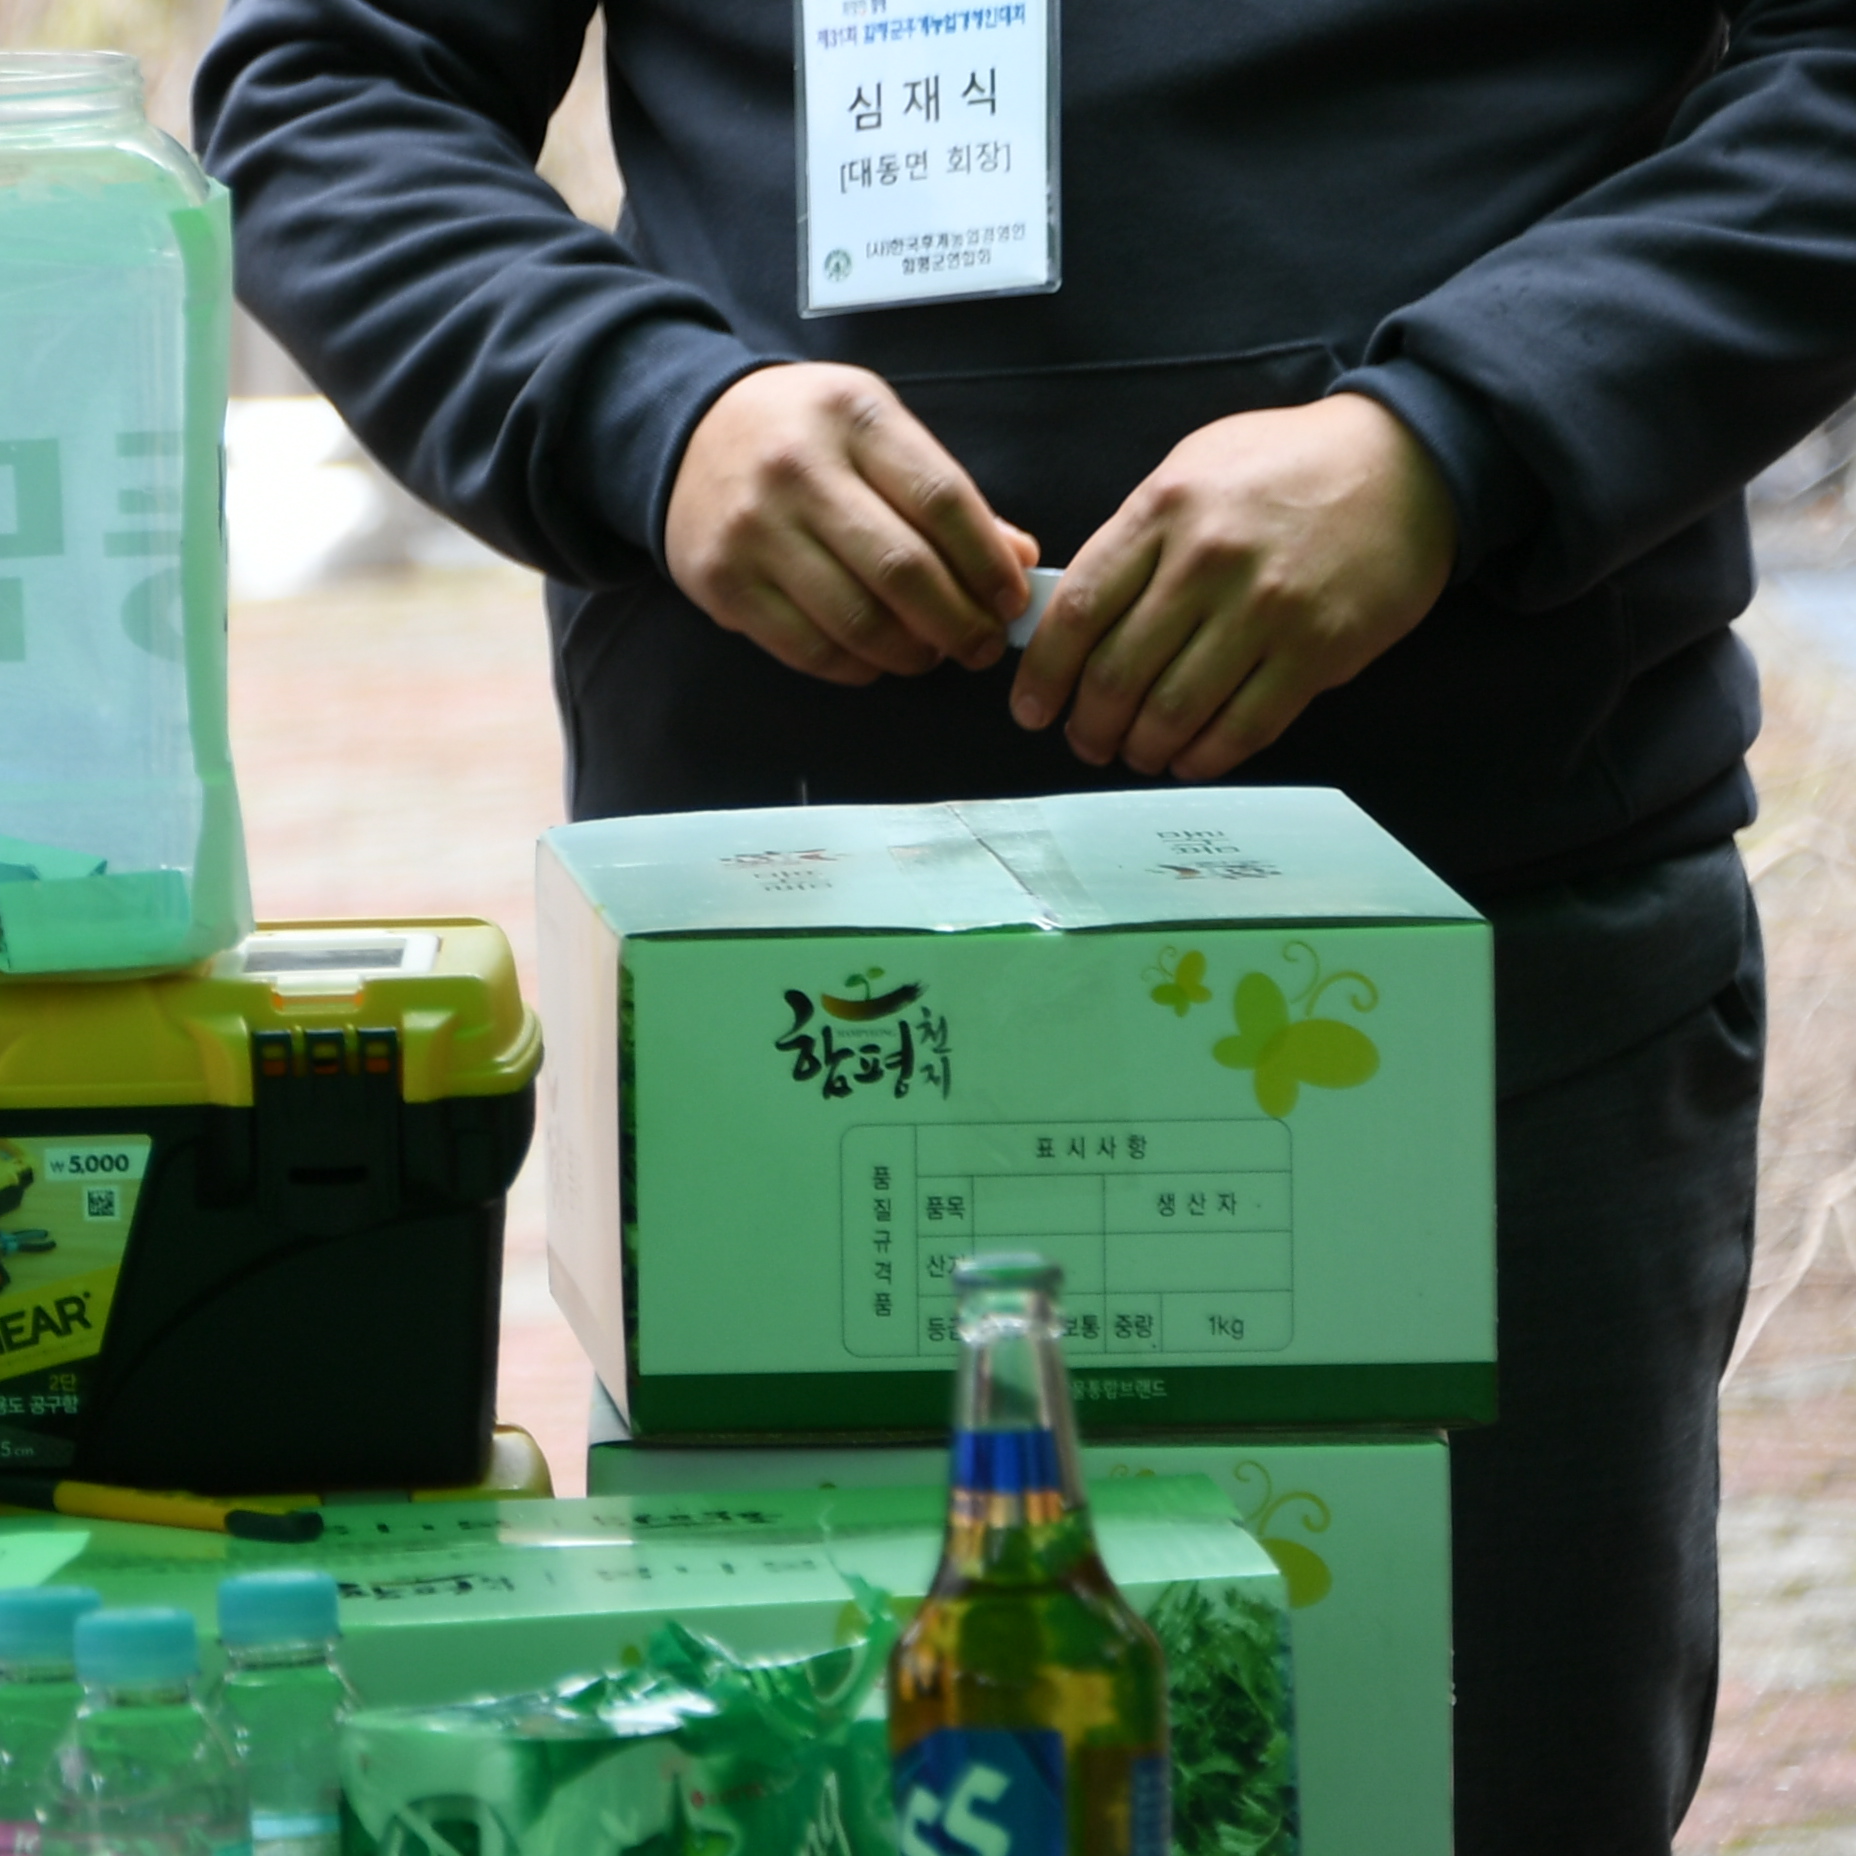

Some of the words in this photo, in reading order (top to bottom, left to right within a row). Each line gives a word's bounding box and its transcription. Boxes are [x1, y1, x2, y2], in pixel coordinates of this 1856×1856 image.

[840, 149, 928, 194] [대동면
[946, 141, 1012, 175] 회장]
[774, 989, 915, 1101] 함평
[927, 1195, 966, 1221] 품목
[1114, 1314, 1154, 1339] 중량
[1207, 1315, 1246, 1341] 1kg
[49, 1374, 77, 1393] 2단
[29, 1395, 80, 1415] 공구함
